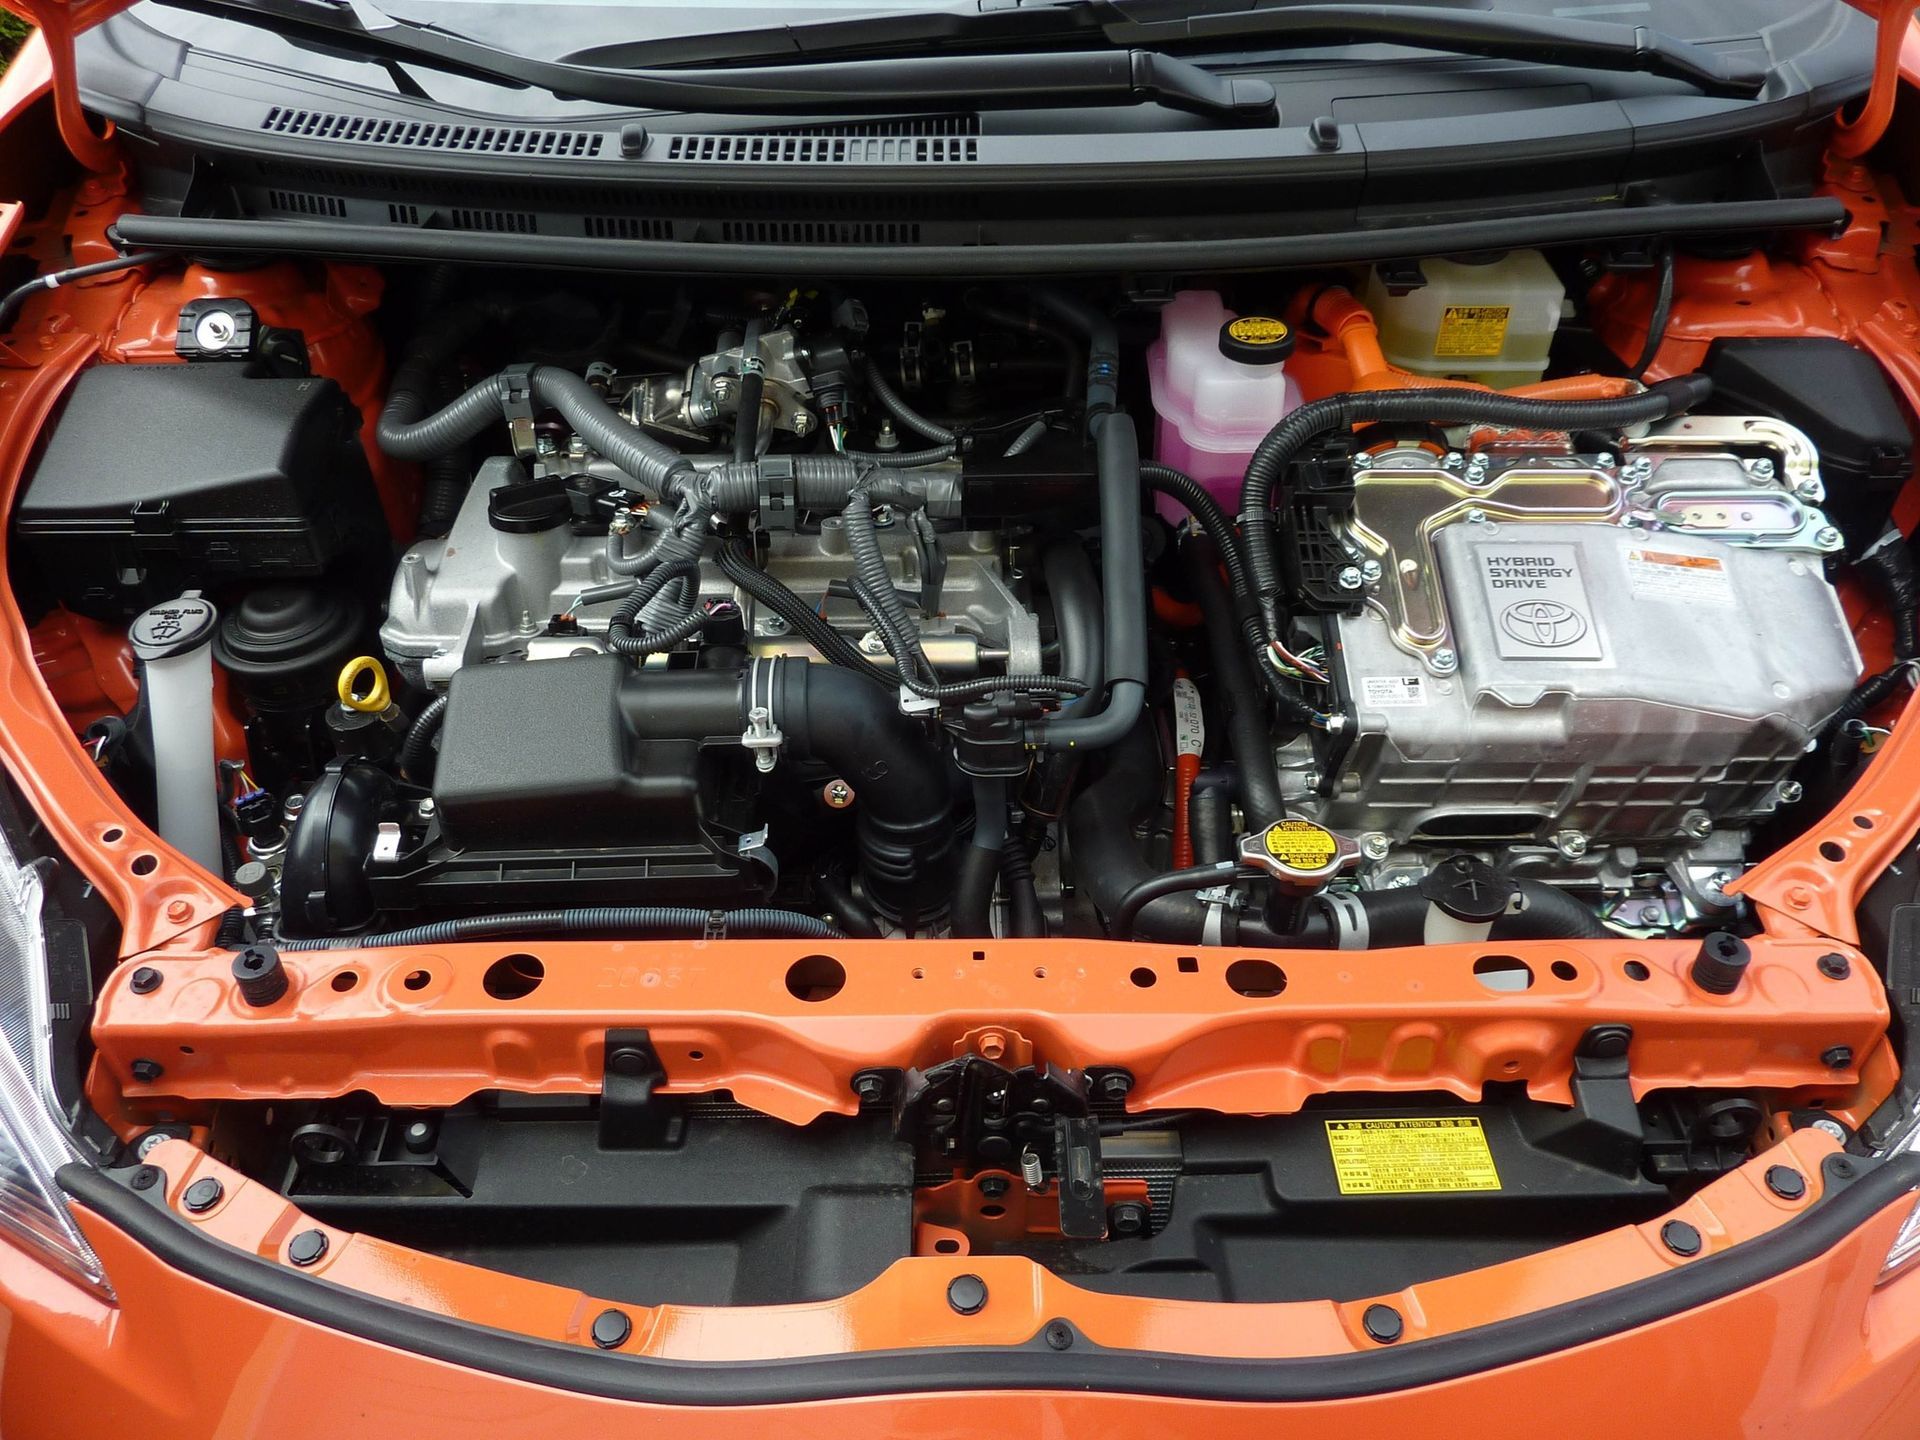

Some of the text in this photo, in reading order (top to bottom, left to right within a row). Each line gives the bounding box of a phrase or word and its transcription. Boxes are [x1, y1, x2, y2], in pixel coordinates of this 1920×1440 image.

[1487, 557, 1555, 566] HYBRID
[1489, 568, 1573, 578] SYNERGY
[1492, 579, 1547, 589] DRIVE
